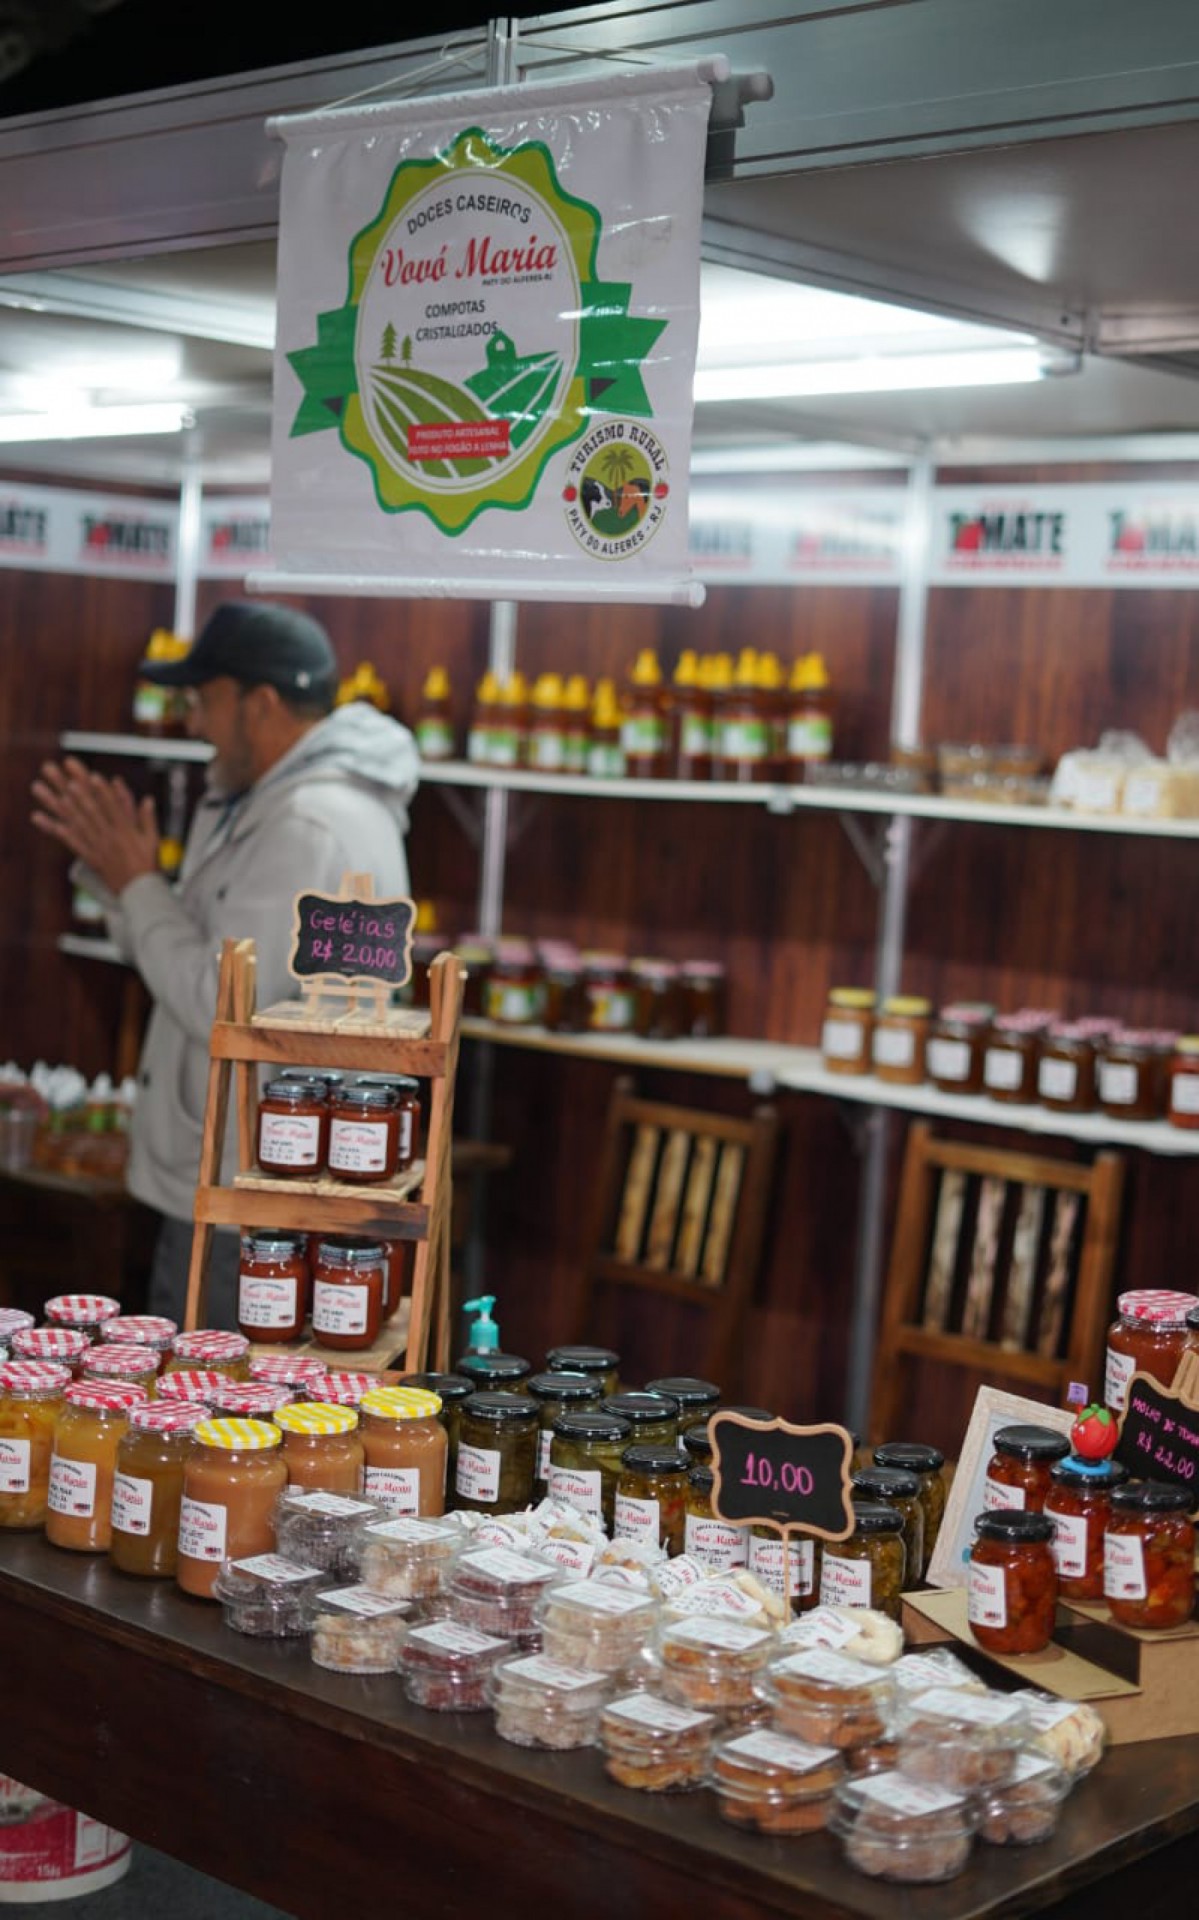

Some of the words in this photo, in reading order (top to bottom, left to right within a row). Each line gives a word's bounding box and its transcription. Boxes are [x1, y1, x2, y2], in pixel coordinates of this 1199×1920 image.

[407, 198, 453, 235] DOCES
[456, 194, 532, 224] CASEIROS
[381, 244, 448, 288] Vovó
[455, 234, 558, 280] Maria
[425, 299, 486, 319] COMPOTAS
[415, 321, 498, 342] CRISTALIZADOS
[570, 424, 625, 472] TURISMO
[629, 425, 665, 472] RURAL
[569, 508, 588, 538] PATY
[586, 534, 600, 550] DO
[601, 529, 645, 555] ALFERES
[650, 505, 662, 524] RJ
[949, 511, 1064, 556] TMATE
[311, 938, 334, 963] R$
[342, 942, 397, 969] 20,00
[1137, 1431, 1152, 1453] R$
